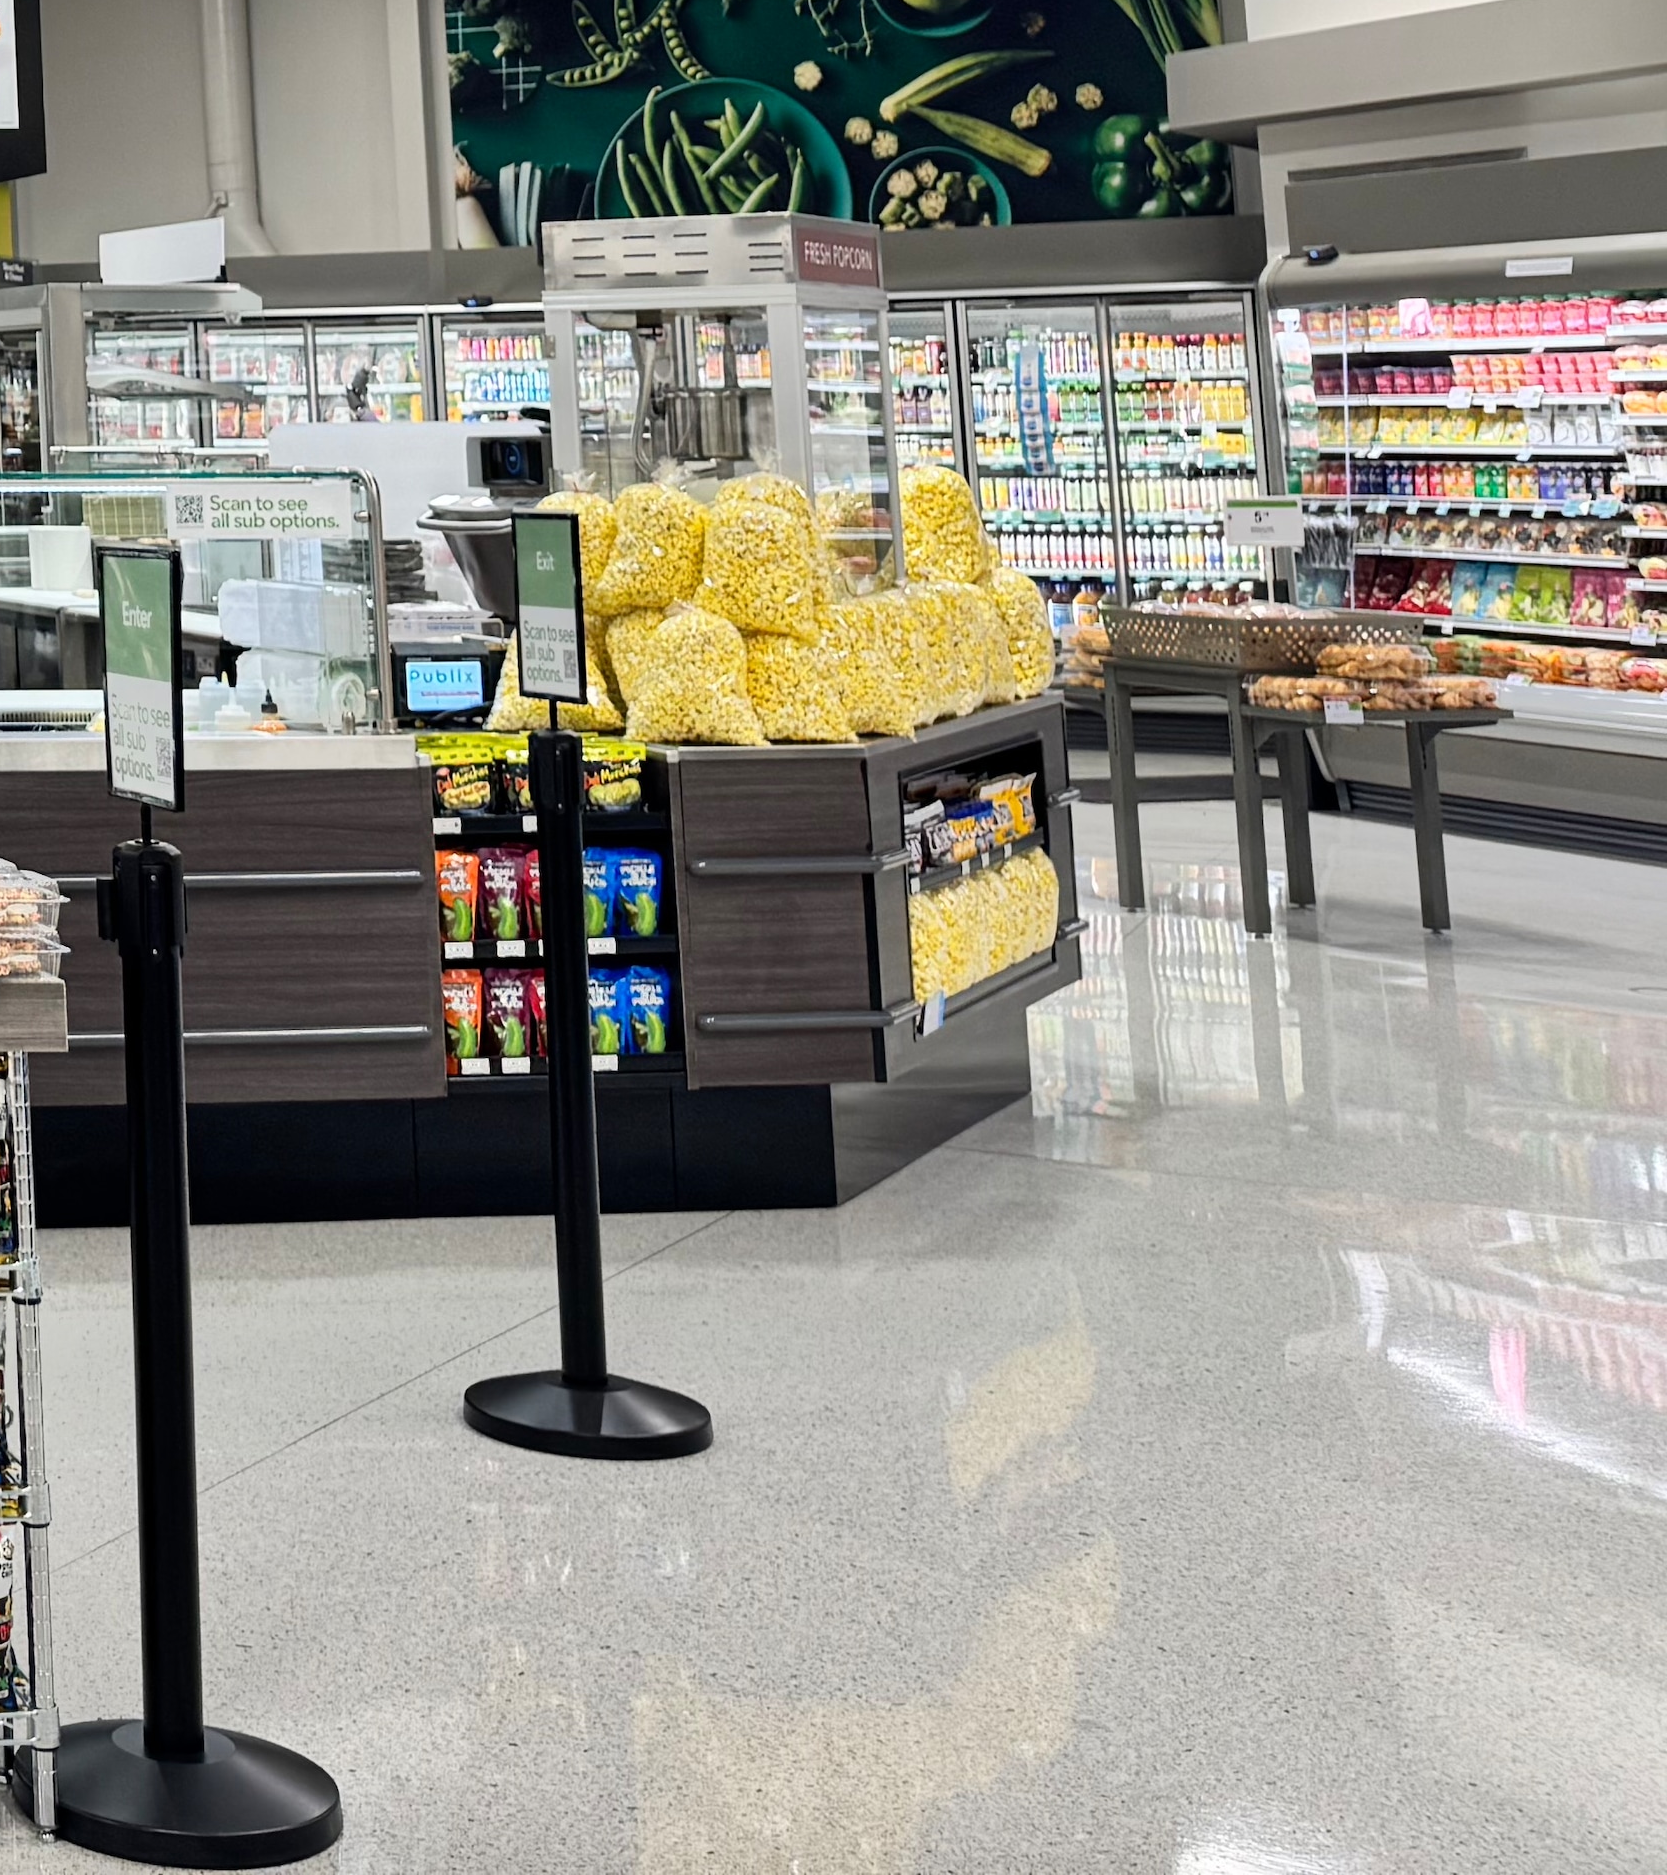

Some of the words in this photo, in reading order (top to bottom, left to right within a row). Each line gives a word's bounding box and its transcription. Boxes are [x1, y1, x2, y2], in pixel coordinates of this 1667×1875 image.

[804, 240, 831, 265] FRESH
[833, 244, 873, 271] POPCORN
[209, 494, 252, 512] Scan
[255, 496, 274, 512] to
[278, 498, 308, 512] see
[211, 512, 230, 529] all
[234, 511, 266, 529] sub
[269, 512, 340, 533] options.
[536, 550, 556, 572] Exit
[121, 600, 153, 629] Enter
[524, 620, 547, 641] Scan
[547, 625, 558, 641] to
[558, 628, 576, 643] see
[525, 642, 537, 660] all
[538, 642, 556, 661] sub
[526, 661, 564, 686] options.
[111, 693, 137, 723] Scan
[137, 702, 150, 725] to
[150, 708, 171, 729] see
[113, 727, 125, 749] all
[126, 728, 147, 750] sub
[114, 754, 156, 784] options.
